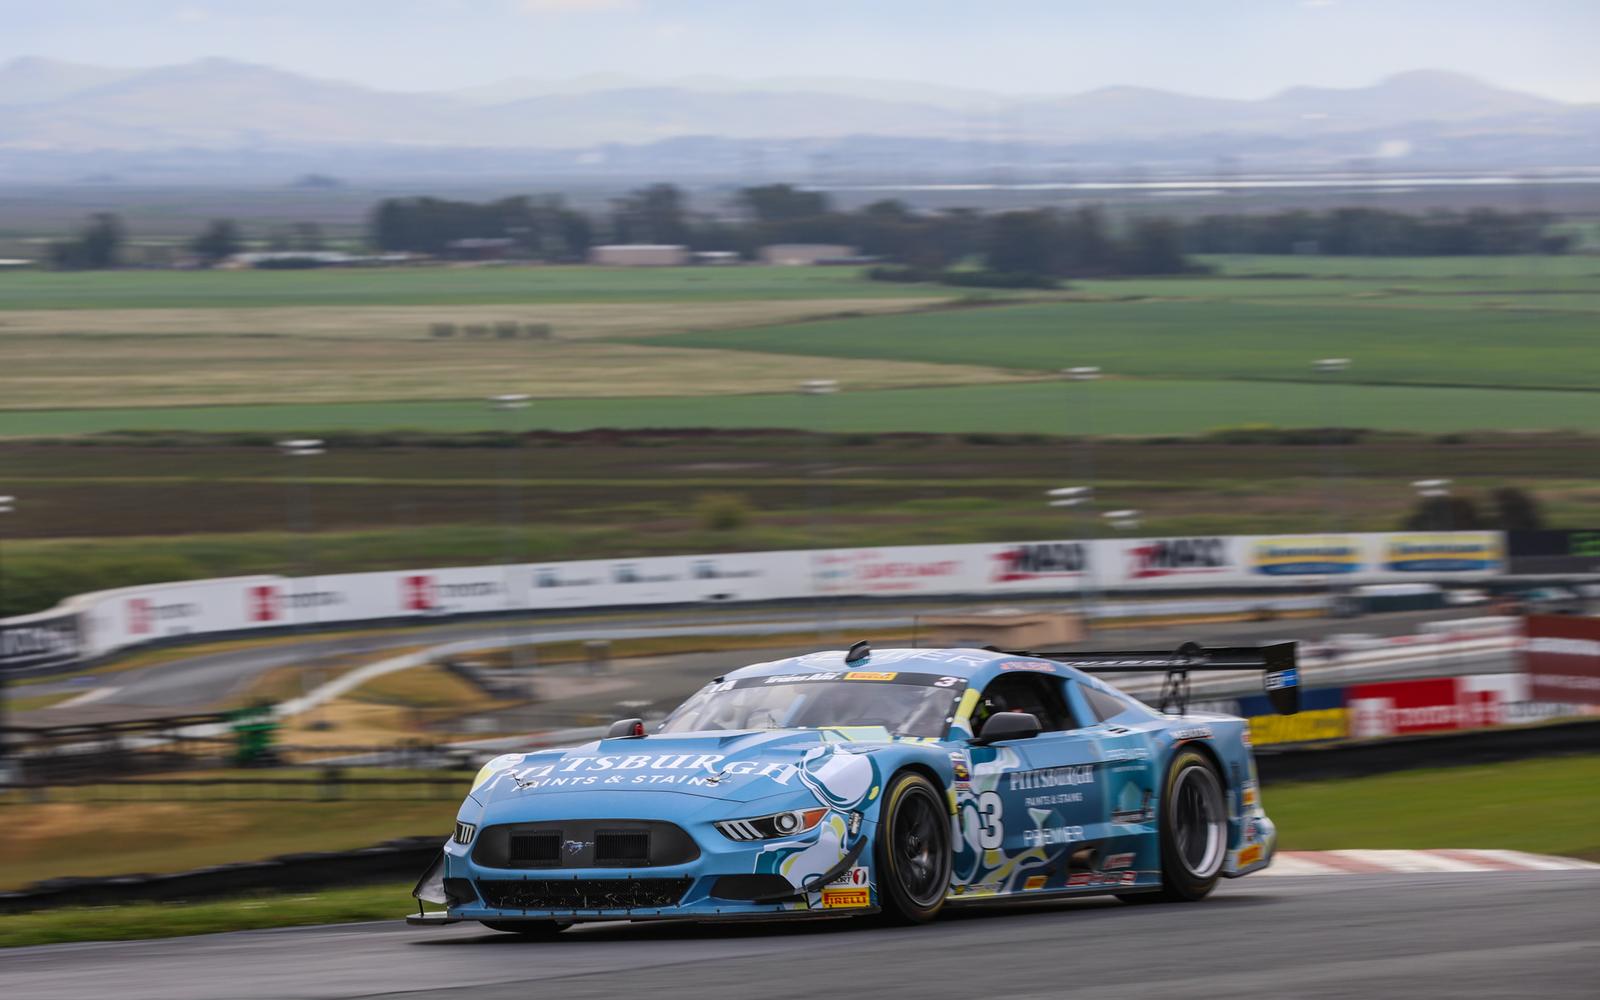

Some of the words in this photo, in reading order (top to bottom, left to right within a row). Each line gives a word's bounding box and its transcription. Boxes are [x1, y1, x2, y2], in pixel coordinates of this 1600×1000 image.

[933, 677, 957, 687] 3
[604, 775, 626, 784] &
[979, 790, 1004, 850] 3
[824, 891, 867, 905] PIRELLI
